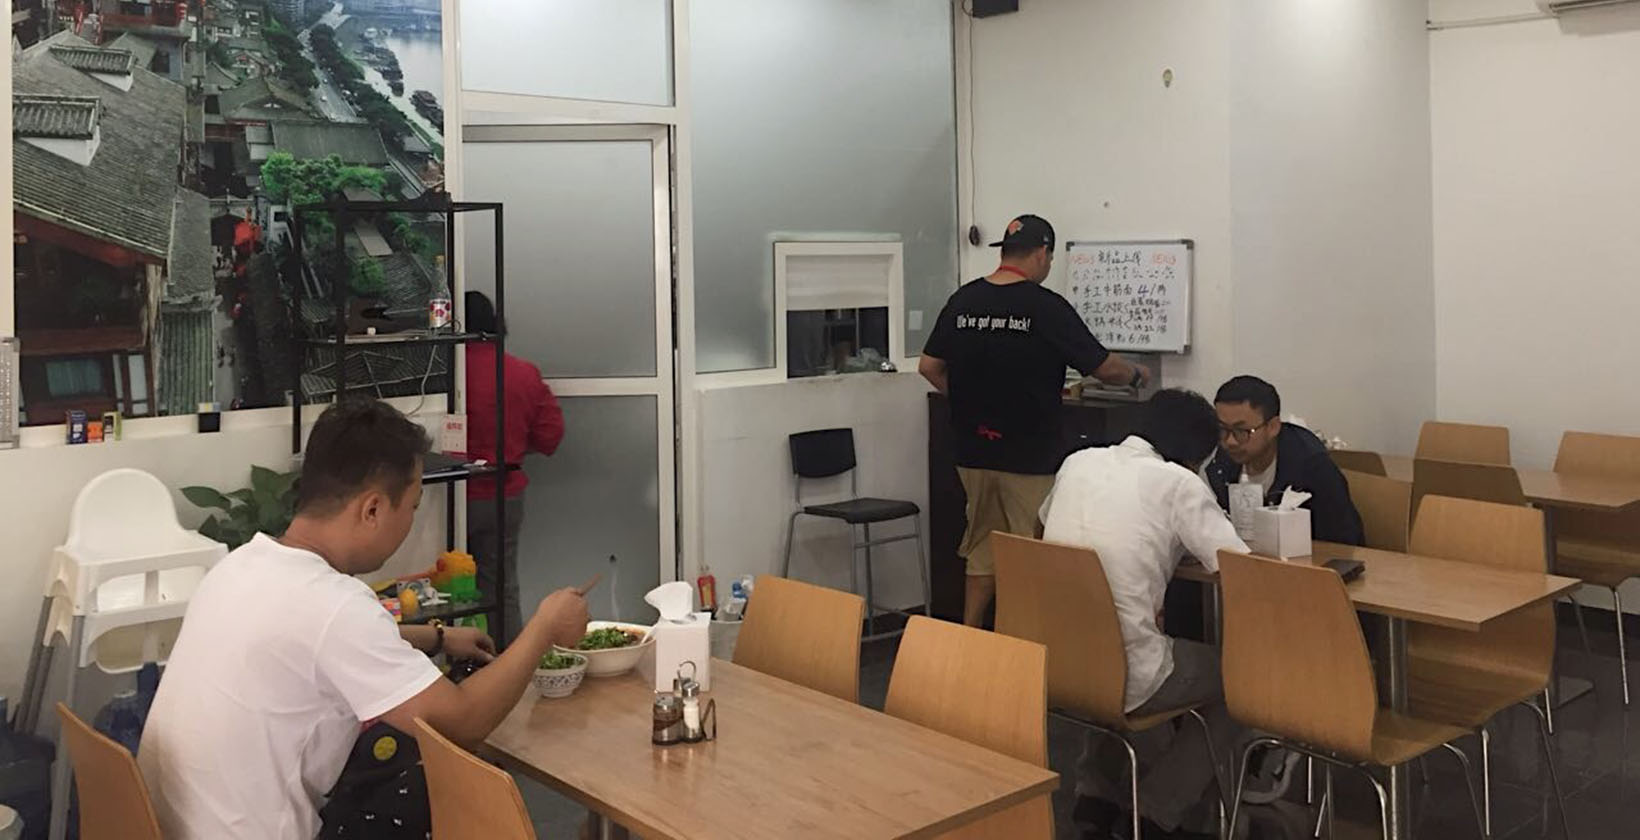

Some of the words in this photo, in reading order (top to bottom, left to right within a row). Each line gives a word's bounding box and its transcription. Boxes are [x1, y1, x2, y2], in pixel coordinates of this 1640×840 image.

[957, 314, 976, 329] We've
[978, 315, 990, 331] got
[991, 318, 1007, 331] your
[1008, 315, 1031, 332] back!
